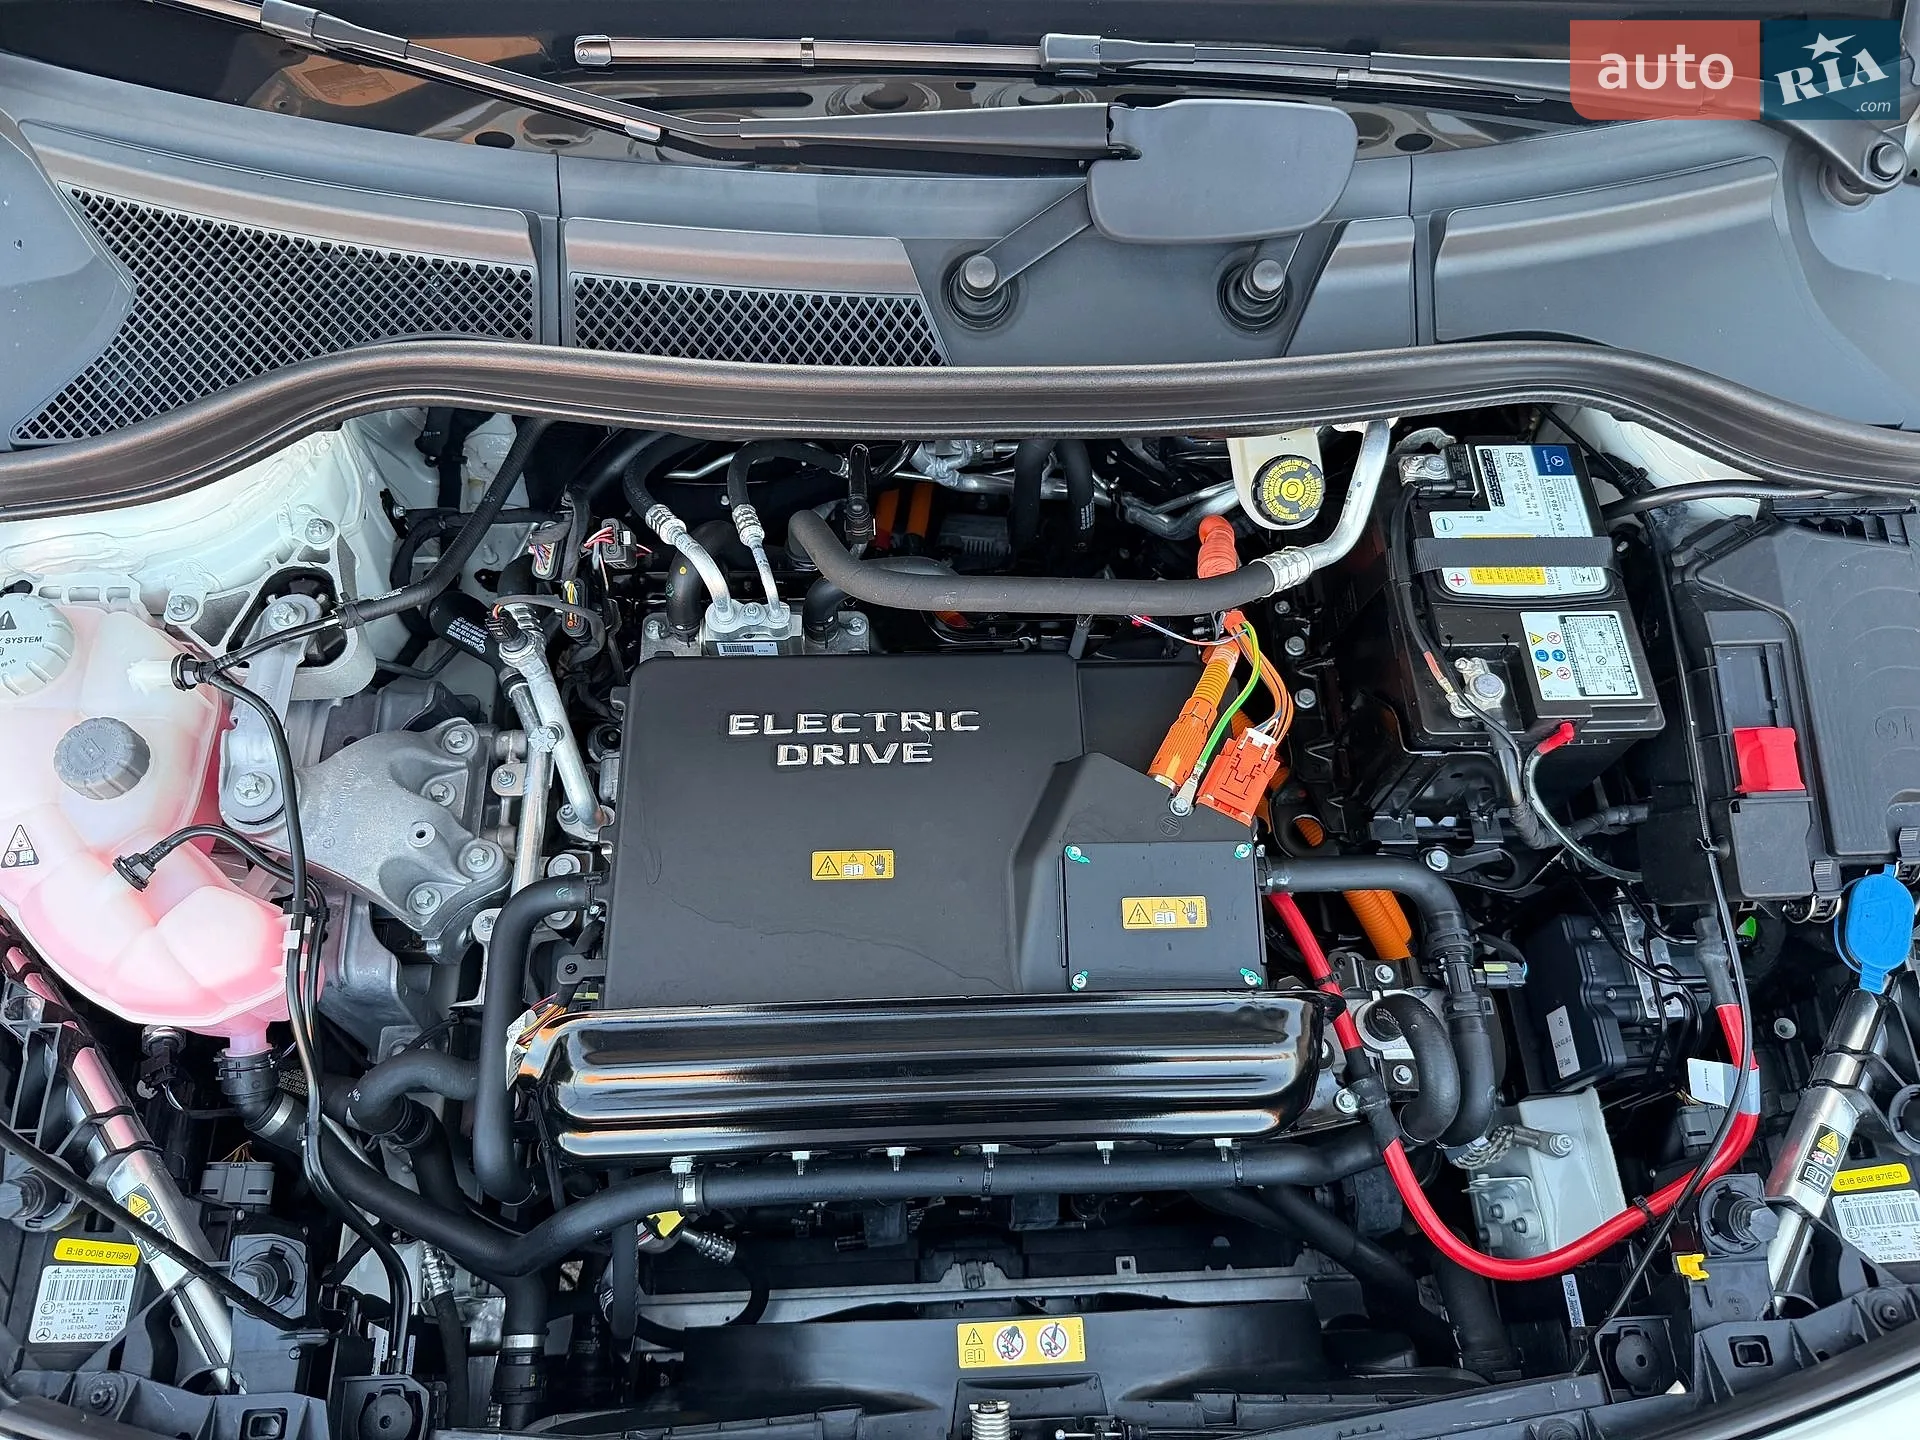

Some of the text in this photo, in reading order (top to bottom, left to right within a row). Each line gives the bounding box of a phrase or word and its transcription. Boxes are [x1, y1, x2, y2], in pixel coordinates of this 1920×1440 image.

[728, 711, 980, 736] ELECTRIC
[776, 742, 933, 766] DRIVE
[66, 1247, 84, 1256] B:18
[85, 1249, 104, 1257] 0018
